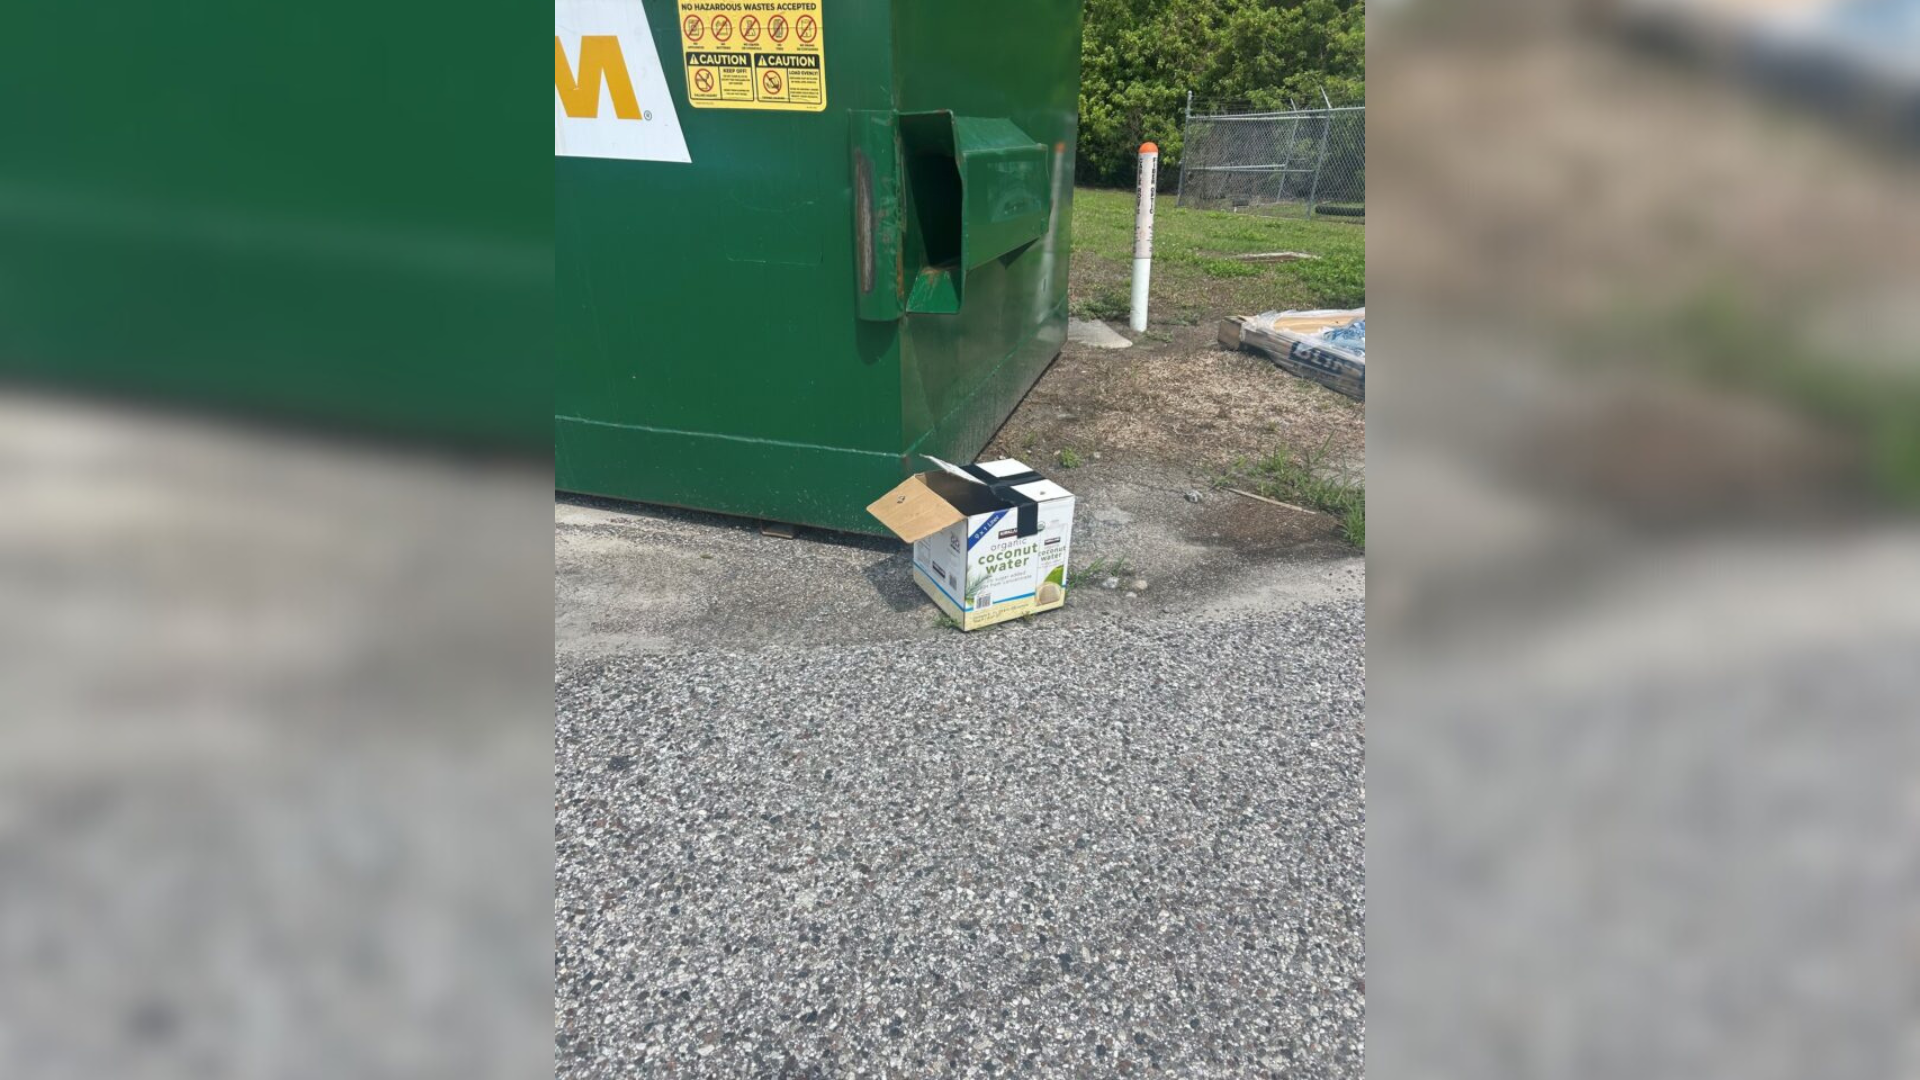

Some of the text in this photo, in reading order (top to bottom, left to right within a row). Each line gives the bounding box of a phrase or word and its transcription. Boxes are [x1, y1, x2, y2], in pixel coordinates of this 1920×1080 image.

[681, 3, 817, 11] NO HAZARDOUS WASTES ACCEPTED
[699, 54, 747, 65] CAUTION
[768, 55, 816, 67] CAUTION
[990, 538, 1027, 551] organic
[978, 543, 1038, 565] coconut
[985, 557, 1030, 574] water
